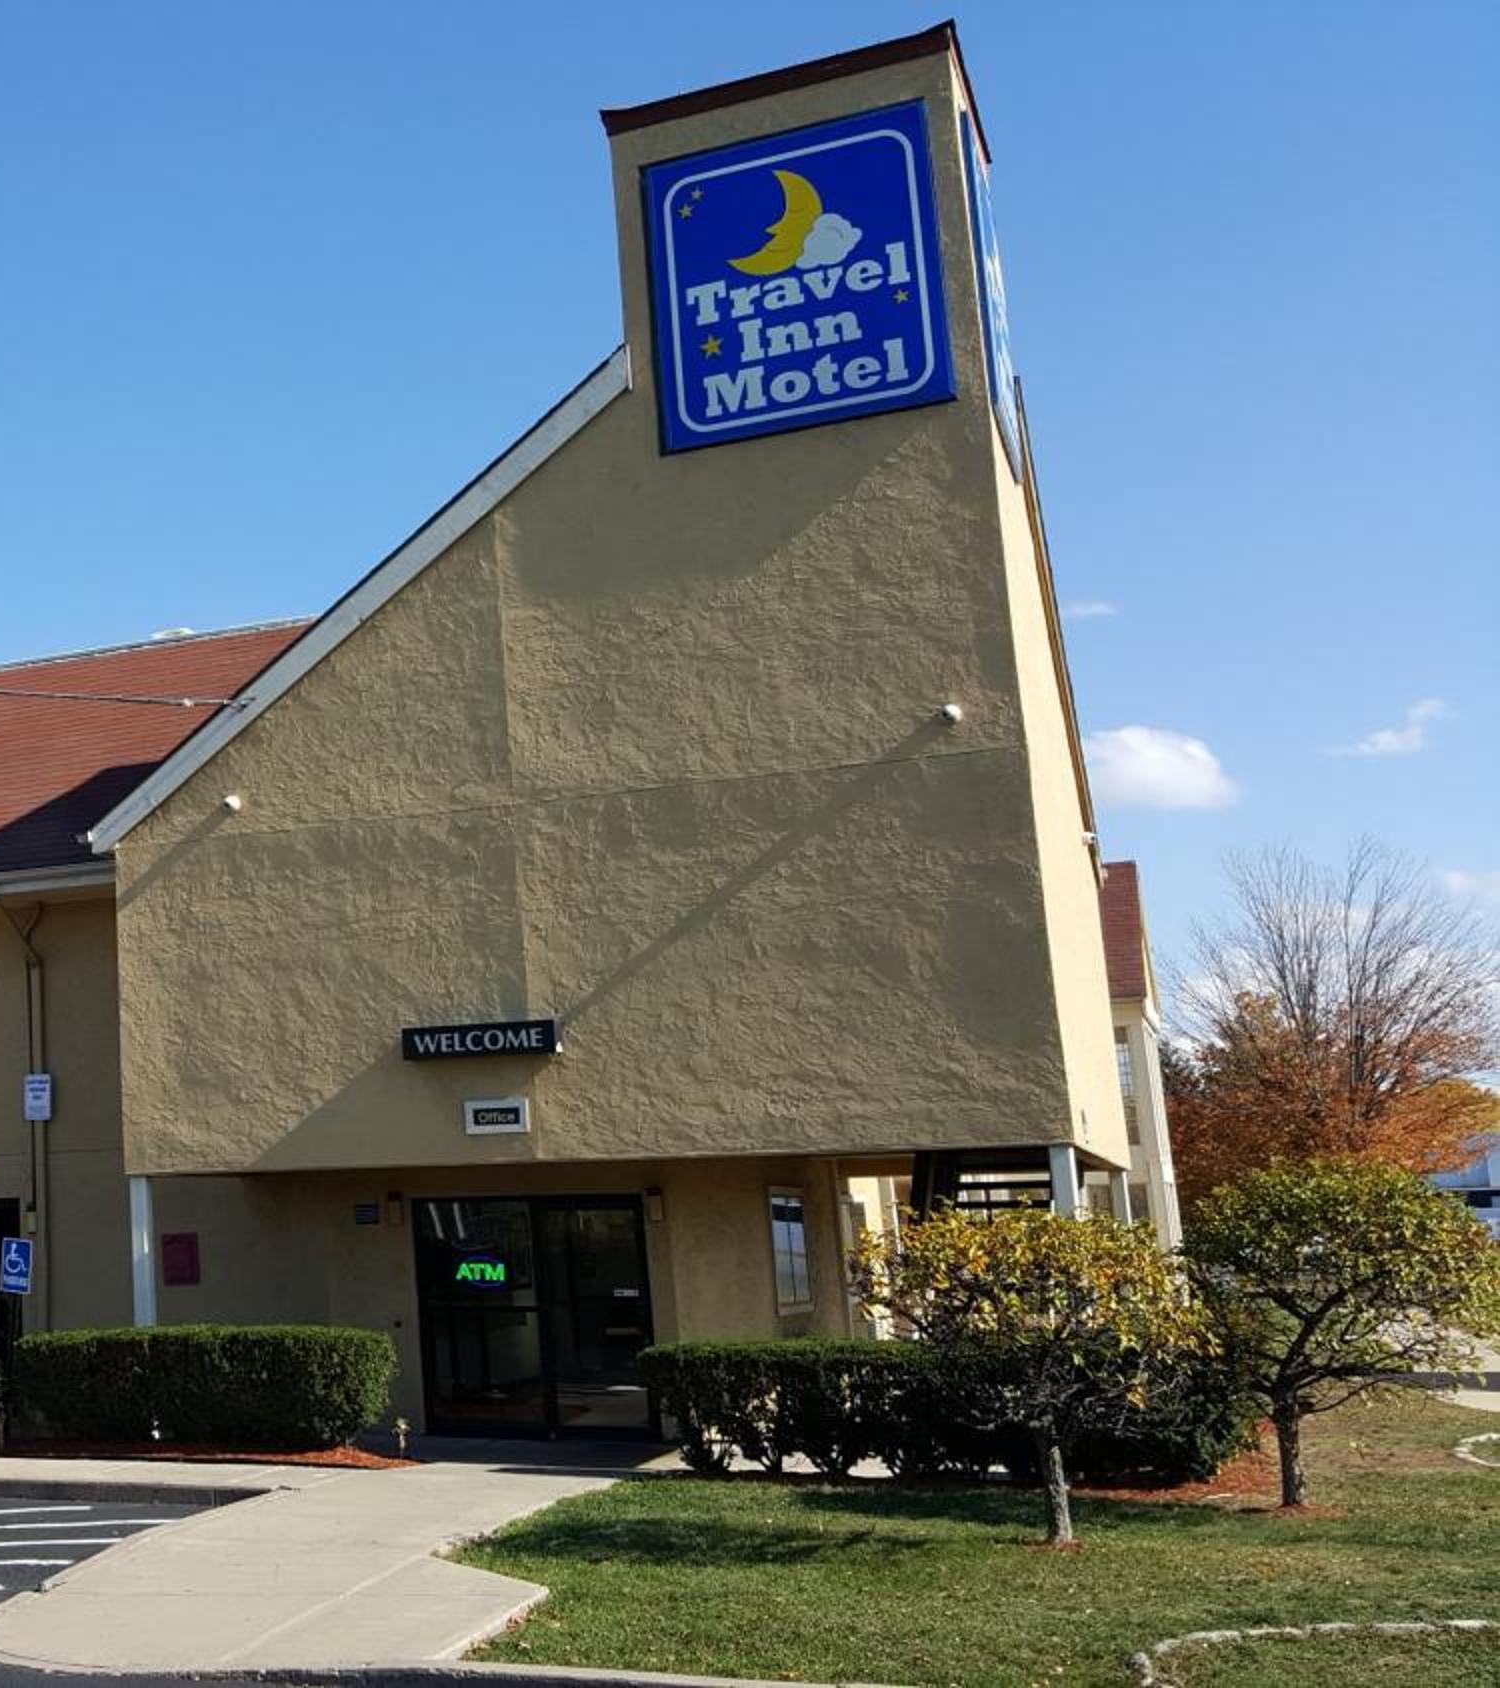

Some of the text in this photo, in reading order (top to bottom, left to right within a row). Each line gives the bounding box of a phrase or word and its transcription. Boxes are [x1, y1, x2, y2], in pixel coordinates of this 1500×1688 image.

[686, 241, 911, 326] Travel
[738, 311, 863, 362] Inn
[703, 338, 909, 417] Motel
[414, 1027, 545, 1054] WELCOME
[477, 1110, 516, 1124] Office
[455, 1263, 505, 1281] ATM
